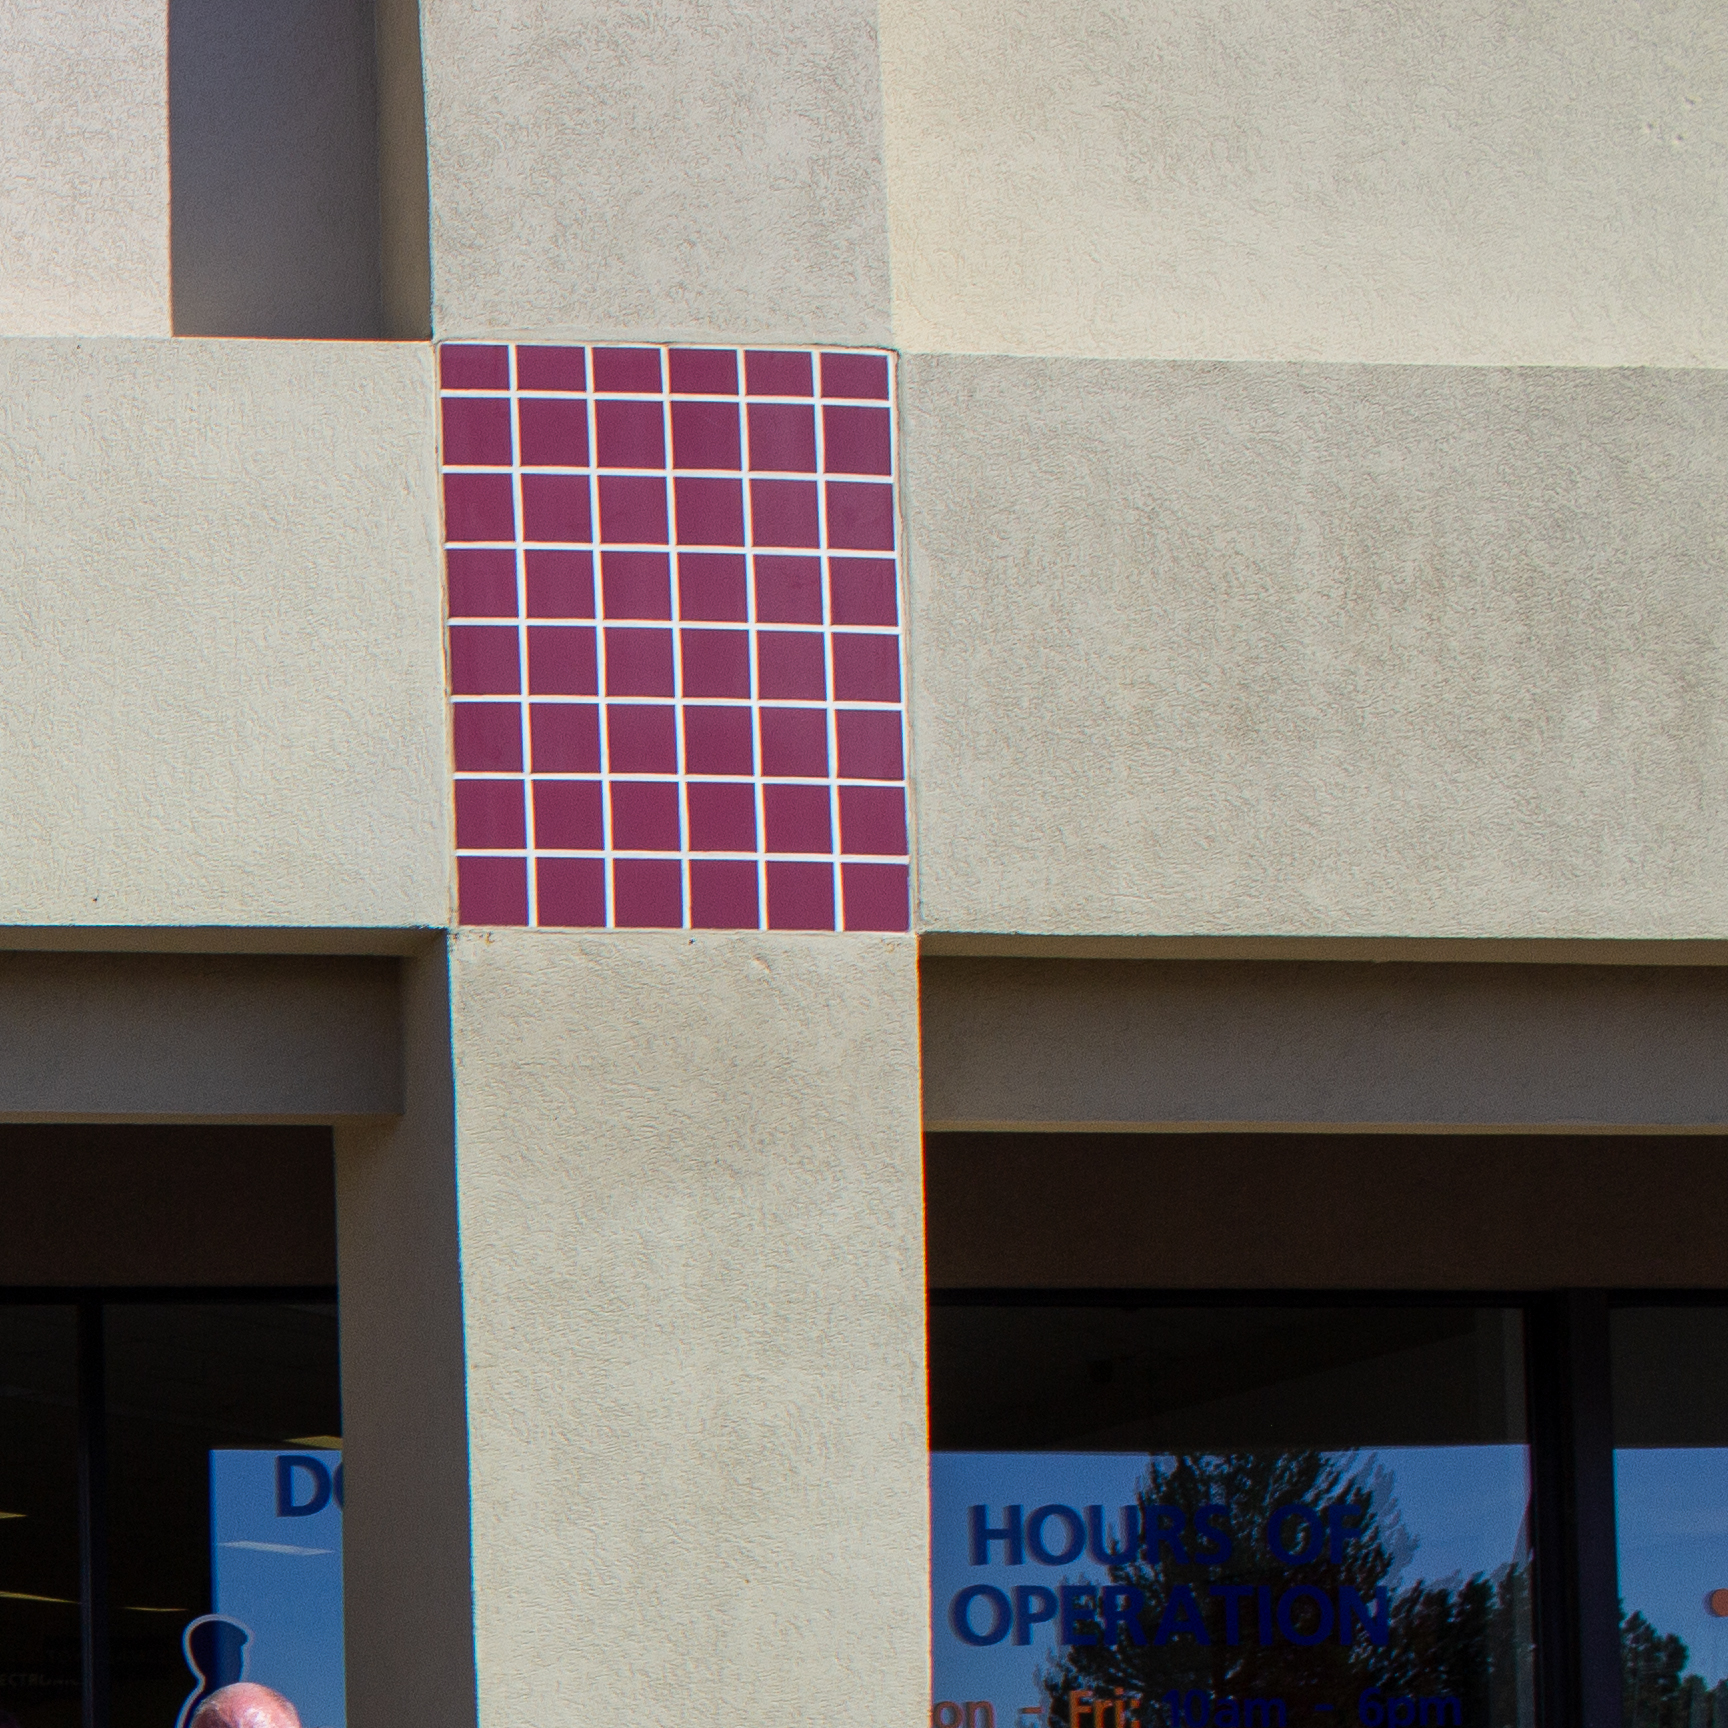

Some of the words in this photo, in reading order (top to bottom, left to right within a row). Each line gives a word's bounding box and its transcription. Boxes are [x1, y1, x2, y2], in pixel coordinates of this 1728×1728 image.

[967, 1503, 1234, 1567] HOURS
[1267, 1502, 1361, 1566] OF
[948, 1583, 1391, 1647] OPERATION
[1161, 1687, 1288, 1728] 10am
